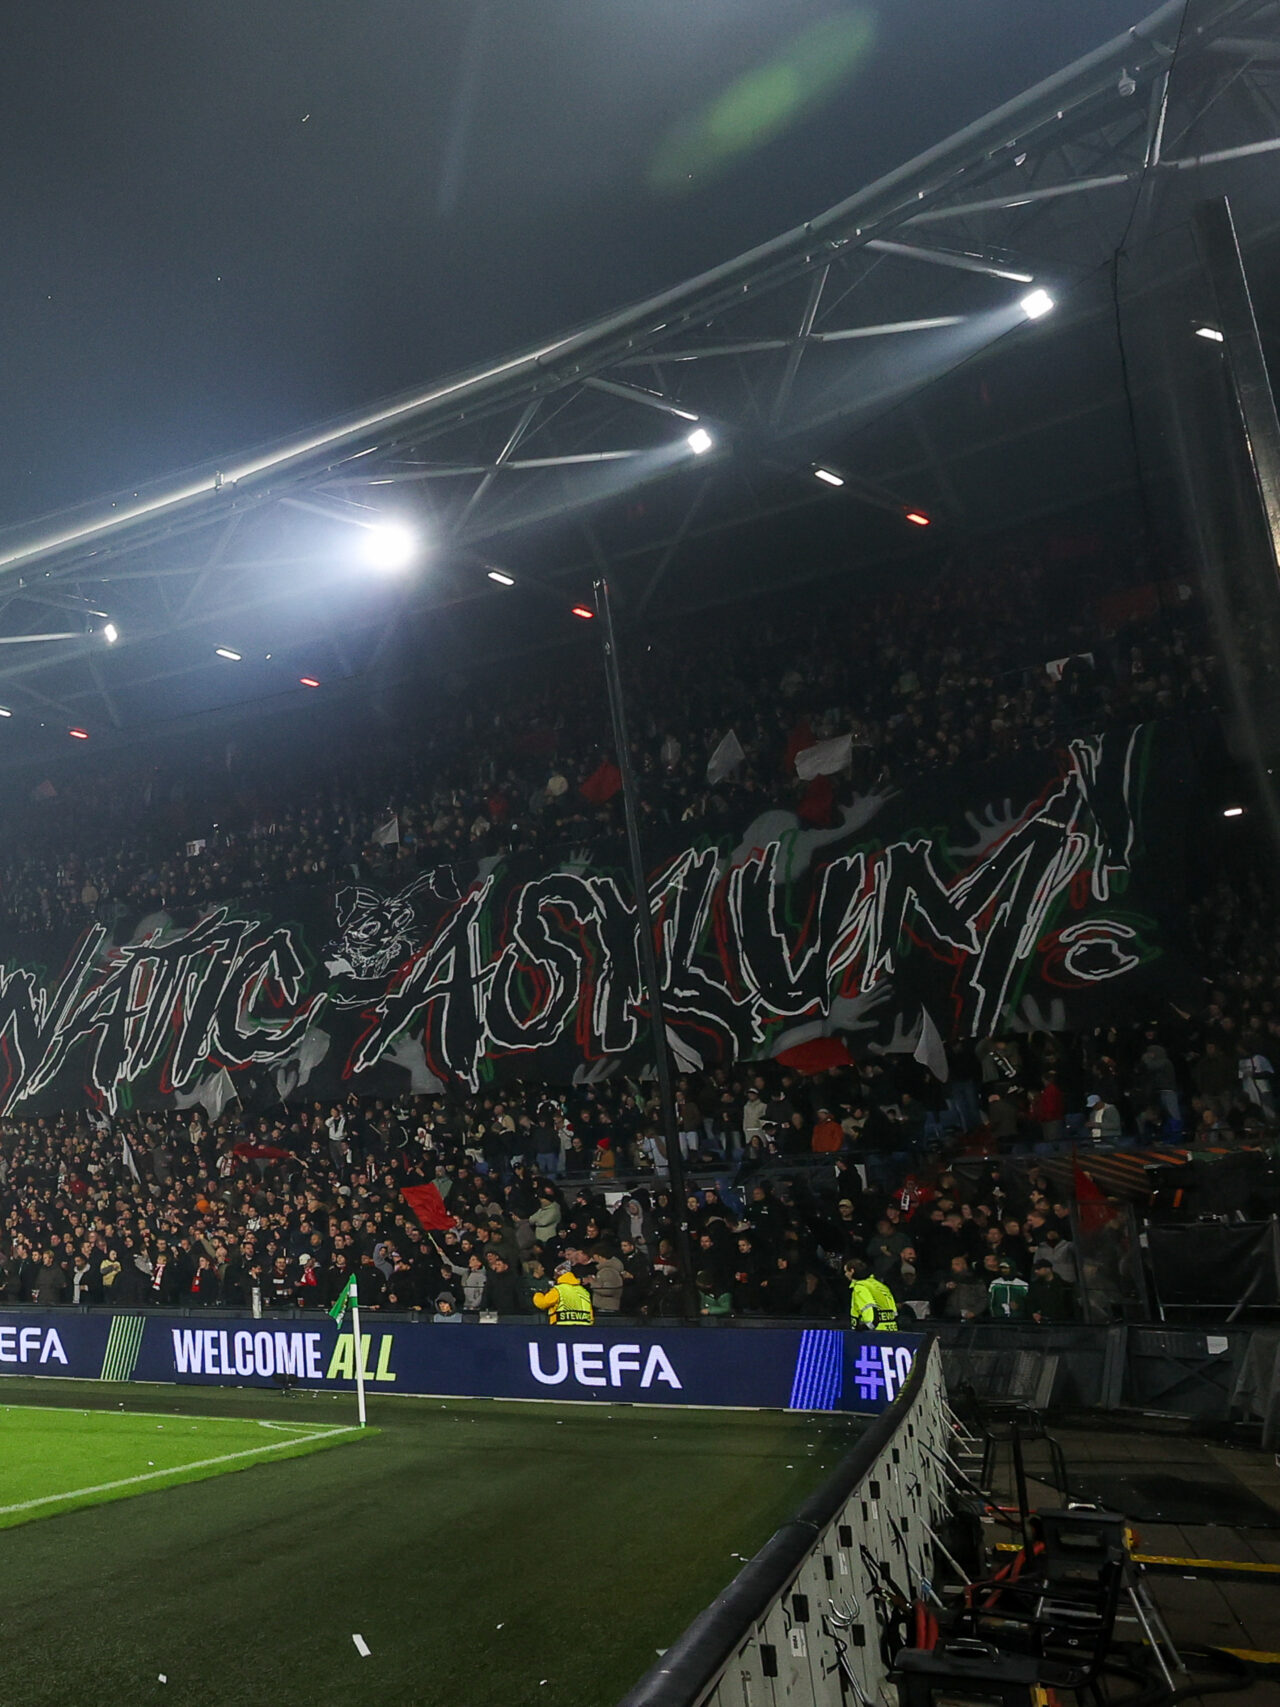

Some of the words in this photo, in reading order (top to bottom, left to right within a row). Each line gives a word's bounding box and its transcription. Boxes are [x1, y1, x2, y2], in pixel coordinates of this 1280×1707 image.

[560, 1311, 591, 1321] STEWA
[172, 1328, 323, 1379] WELCOME
[326, 1333, 398, 1382] ALL
[528, 1341, 683, 1390] UEFA
[855, 1345, 918, 1402] #FO
